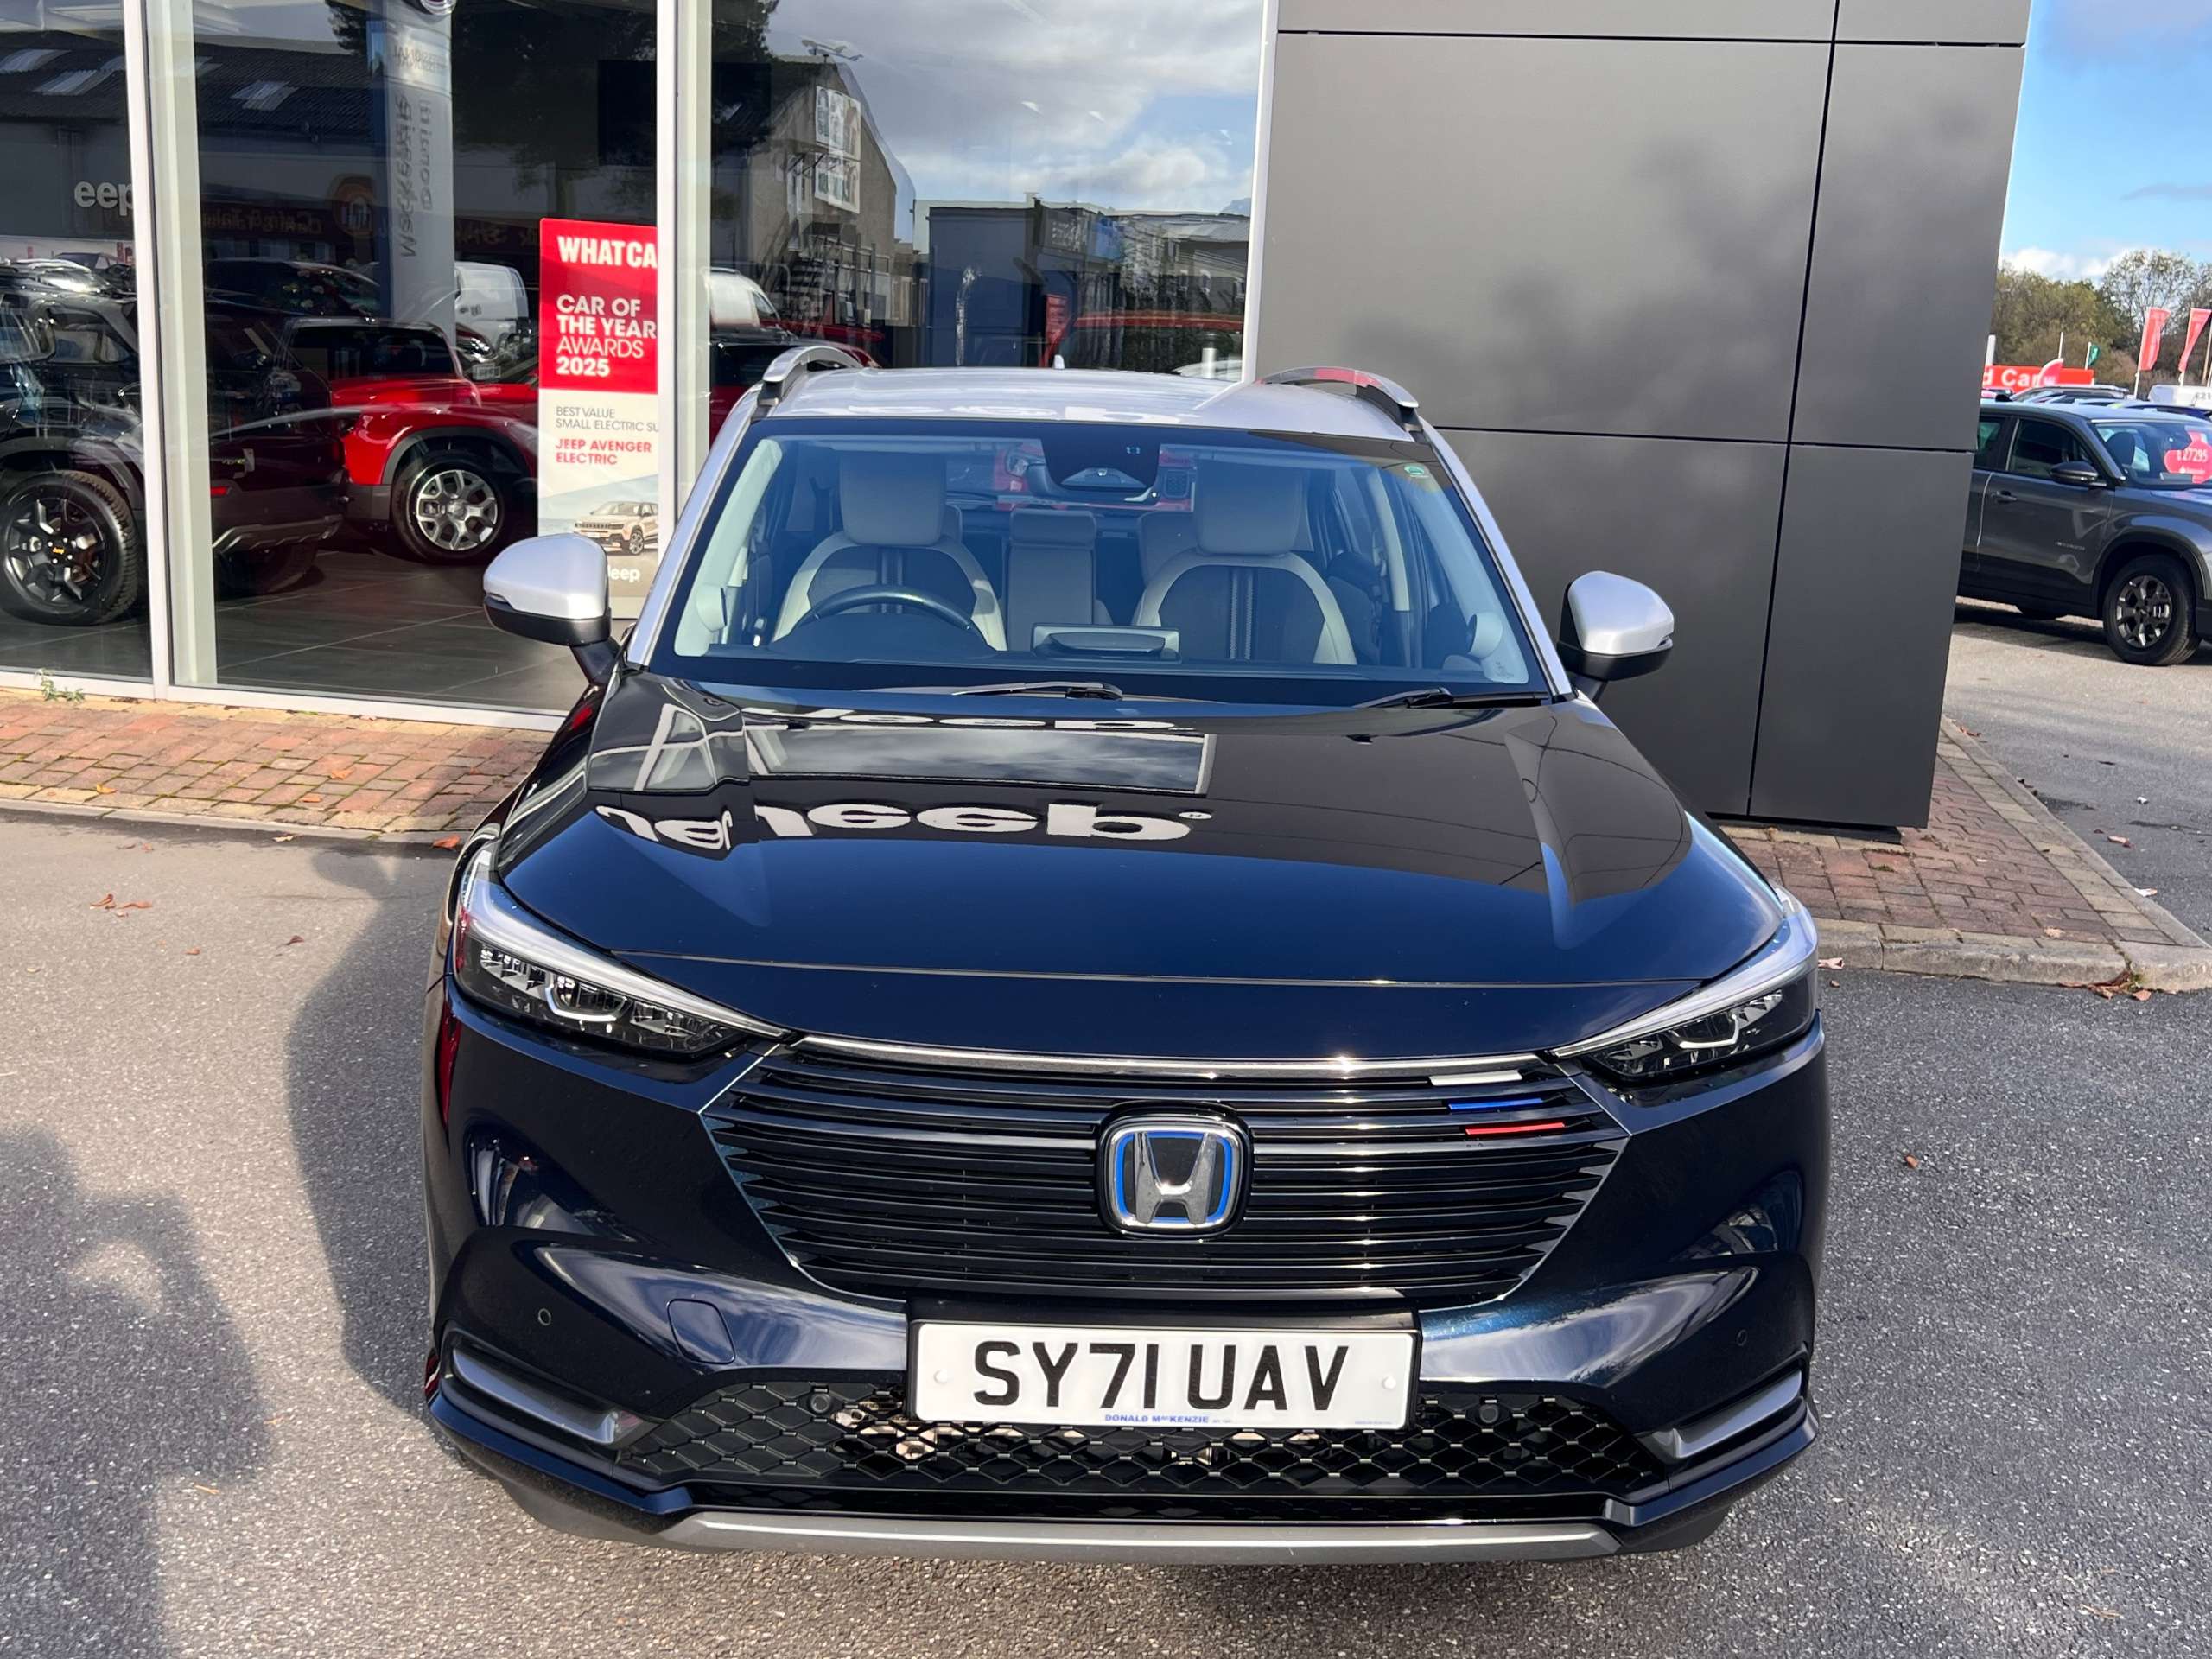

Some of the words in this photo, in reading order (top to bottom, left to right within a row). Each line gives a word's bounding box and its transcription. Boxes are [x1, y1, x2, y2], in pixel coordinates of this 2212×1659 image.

[557, 236, 625, 266] WHAT
[556, 294, 605, 315] CAR
[612, 297, 641, 317] OF
[556, 315, 596, 334] THE
[601, 318, 657, 339] YEAR
[556, 336, 644, 358] AWARDS
[556, 356, 610, 377] 2025
[556, 406, 580, 416] BEST
[582, 408, 615, 418] VALUE
[556, 418, 591, 429] SMALL
[594, 421, 644, 431] ELECTRIC
[556, 439, 586, 450] JEEP
[590, 441, 652, 453] AVENGER
[556, 453, 618, 465] ELECTRIC
[974, 1341, 1159, 1408] SY71
[1187, 1344, 1349, 1410] UAV
